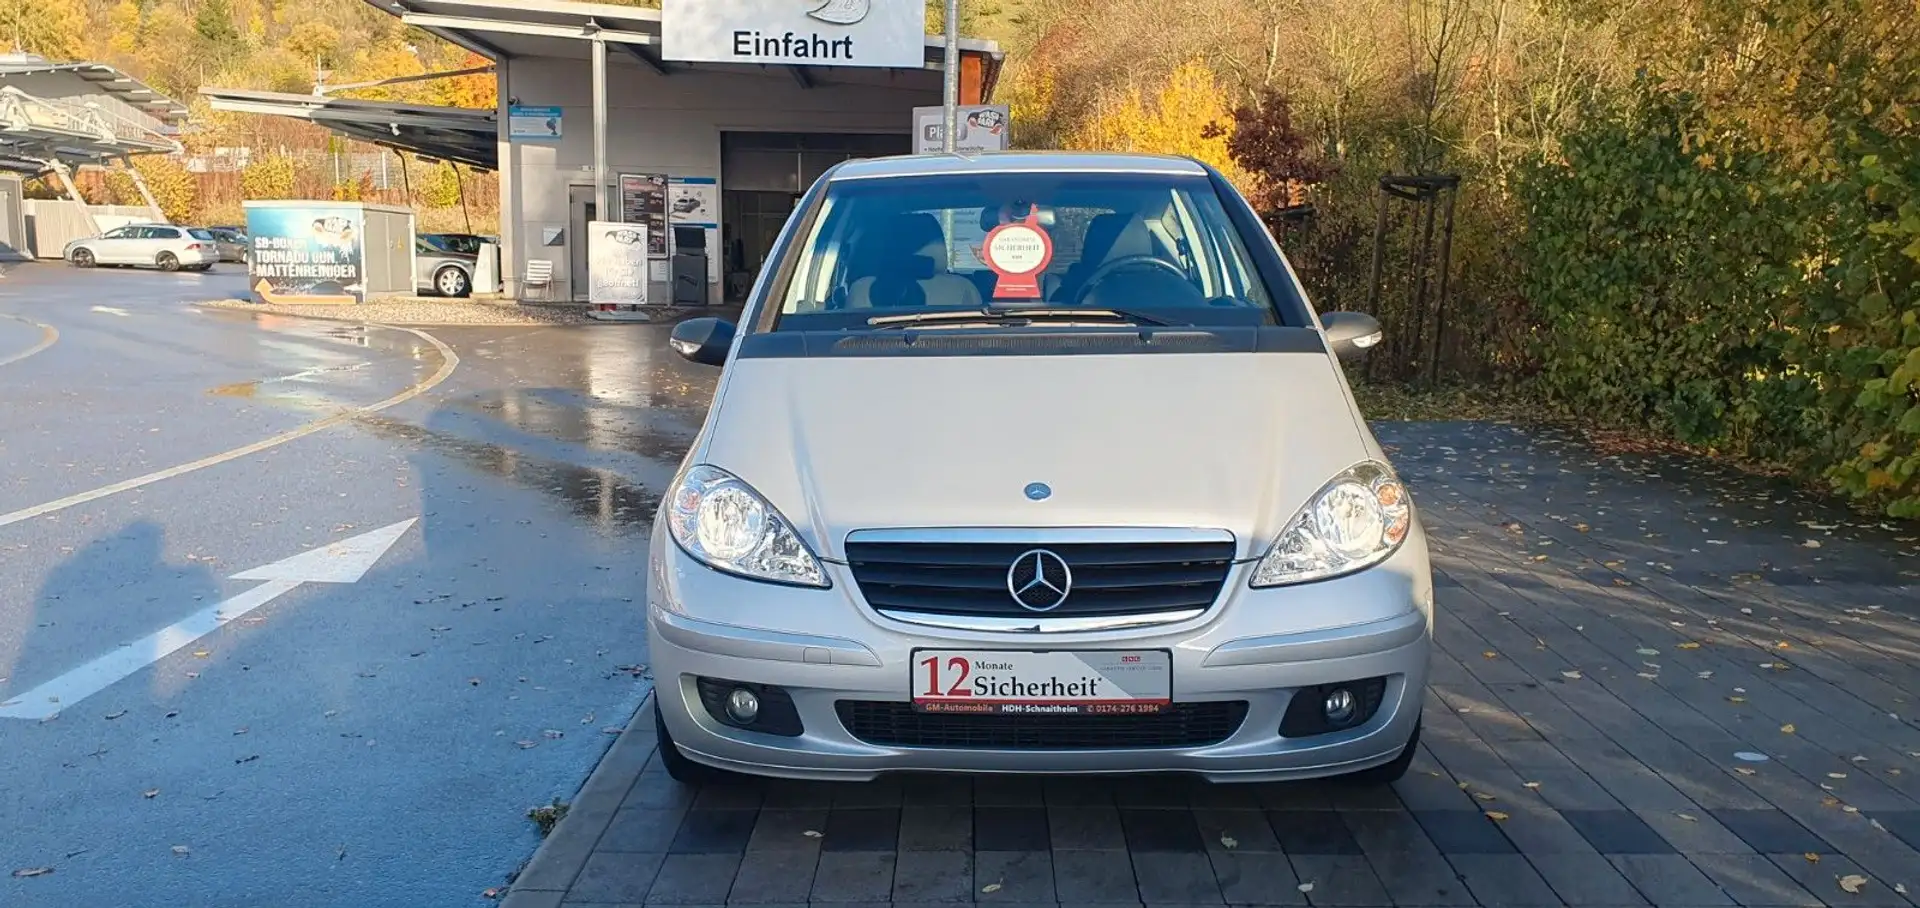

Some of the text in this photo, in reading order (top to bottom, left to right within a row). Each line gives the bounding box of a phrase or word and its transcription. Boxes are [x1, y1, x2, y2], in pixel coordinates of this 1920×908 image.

[733, 31, 853, 59] Einfahrt
[255, 250, 309, 263] TORNADO
[920, 656, 1014, 697] 12 Monate
[926, 703, 994, 713] GM-Automobile
[1002, 704, 1079, 714] HDH-Schnaitheim
